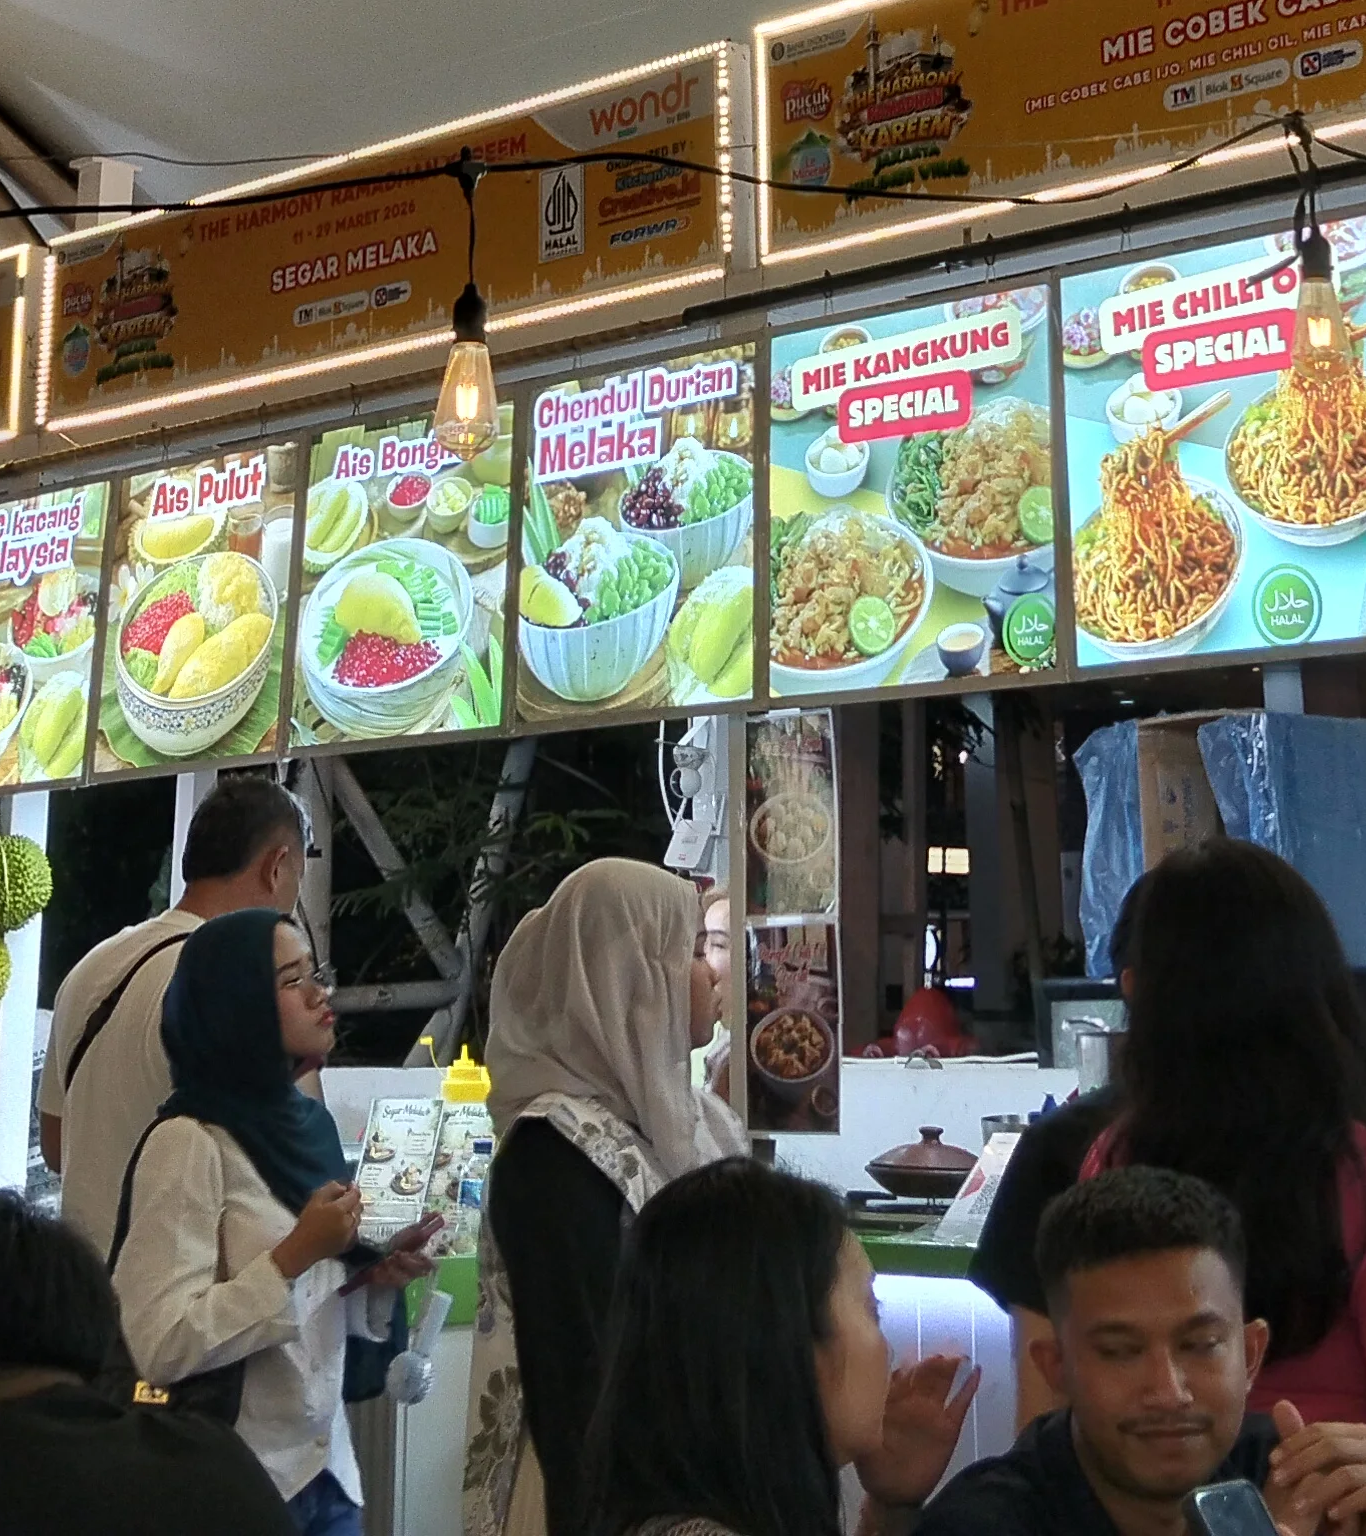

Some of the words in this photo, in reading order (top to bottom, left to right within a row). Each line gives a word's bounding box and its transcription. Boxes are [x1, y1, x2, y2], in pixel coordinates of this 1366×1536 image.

[1102, 27, 1155, 64] MIE
[878, 70, 963, 98] HARMONY
[1025, 91, 1055, 114] (MIE
[1061, 80, 1107, 104] COBEK
[1113, 71, 1151, 90] CABE
[1156, 63, 1185, 81] IJO,
[1190, 53, 1216, 71] MIE
[1222, 42, 1263, 63] CHILI
[1268, 34, 1298, 52] OIL,
[1303, 23, 1332, 43] MIE
[1205, 82, 1229, 97] Blok
[1244, 67, 1284, 86] Square
[588, 69, 699, 136] wondr
[671, 140, 687, 156] BY
[856, 114, 954, 163] KAREEM
[199, 217, 230, 243] THE
[235, 192, 327, 234] HARMONY
[335, 208, 381, 237] MARET
[544, 233, 578, 251] HALAL
[271, 256, 339, 292] SEGAR
[346, 231, 438, 274] MELAKA
[1112, 301, 1165, 337] MIE
[1172, 278, 1265, 320] CHILLI
[801, 362, 847, 396] MIE
[853, 321, 1011, 383] KANGKUNG
[1154, 324, 1287, 374] SPECIAL
[538, 378, 638, 428] Chendul
[647, 365, 734, 405] Durian
[847, 384, 960, 428] SPECIAL
[335, 449, 372, 480] Ais
[538, 425, 656, 476] Melaka
[151, 483, 189, 517] Ais
[198, 463, 263, 507] Pulut
[12, 499, 82, 536] kacang
[1263, 590, 1310, 613] حلال
[1270, 613, 1305, 626] HALAL
[1013, 614, 1049, 634] حلال
[1017, 634, 1045, 647] HALAL
[382, 1105, 403, 1120] Segar
